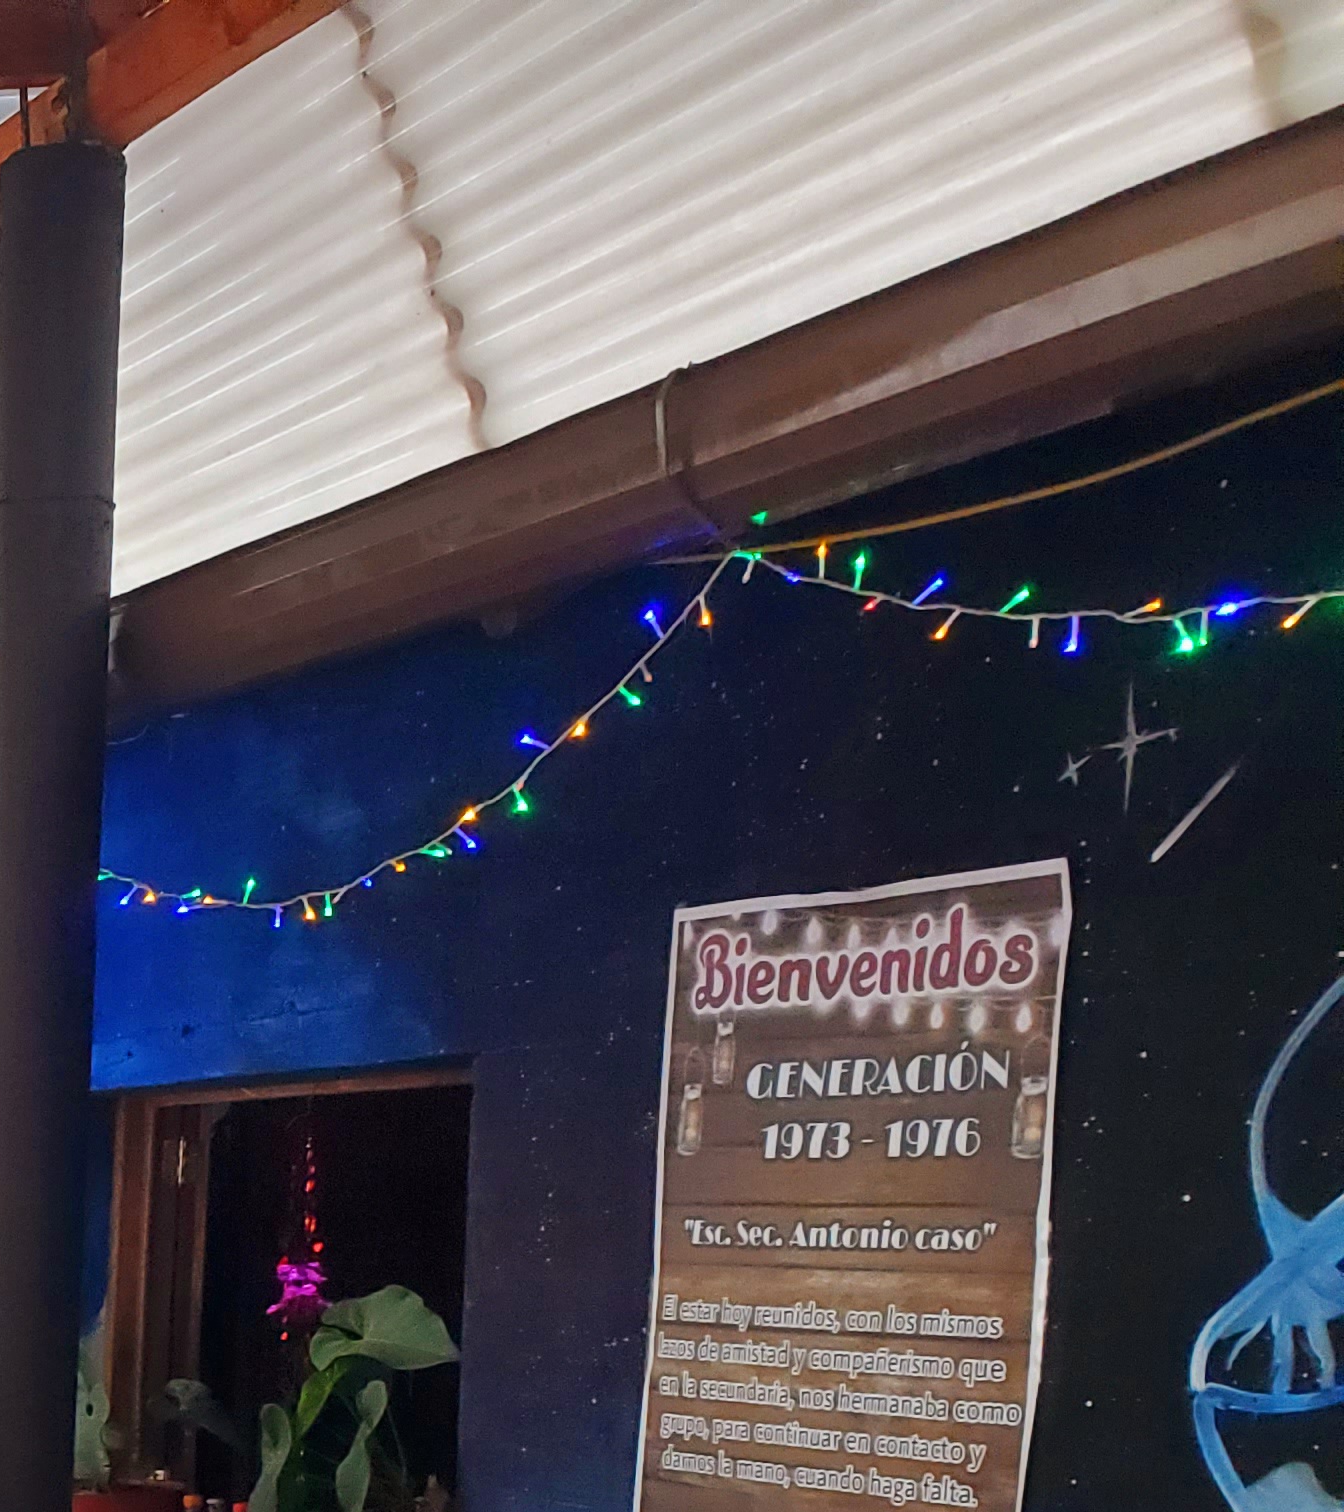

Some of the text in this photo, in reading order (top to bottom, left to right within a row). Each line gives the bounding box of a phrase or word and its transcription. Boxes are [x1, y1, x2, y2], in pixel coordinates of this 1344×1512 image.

[694, 905, 1036, 1012] Bienvenidos
[746, 1041, 1011, 1100] GENERACIÓN
[761, 1121, 852, 1160] 1973
[885, 1117, 981, 1158] 1976
[684, 1219, 998, 1251] "Esc. Sec. Antonio caso"
[662, 1294, 1004, 1339] El estar hoy reunidos, con los mismos
[658, 1331, 1007, 1388] lazos de amistad y compañerismo que
[659, 1371, 1023, 1426] en la secundaria, nos hermanaba como
[660, 1413, 987, 1473] grupo, para continuar en contacto y
[718, 1450, 733, 1478] la
[736, 1459, 791, 1489] mano,
[794, 1464, 864, 1494] cuando
[868, 1467, 917, 1506] haga
[921, 1472, 978, 1508] falta.
